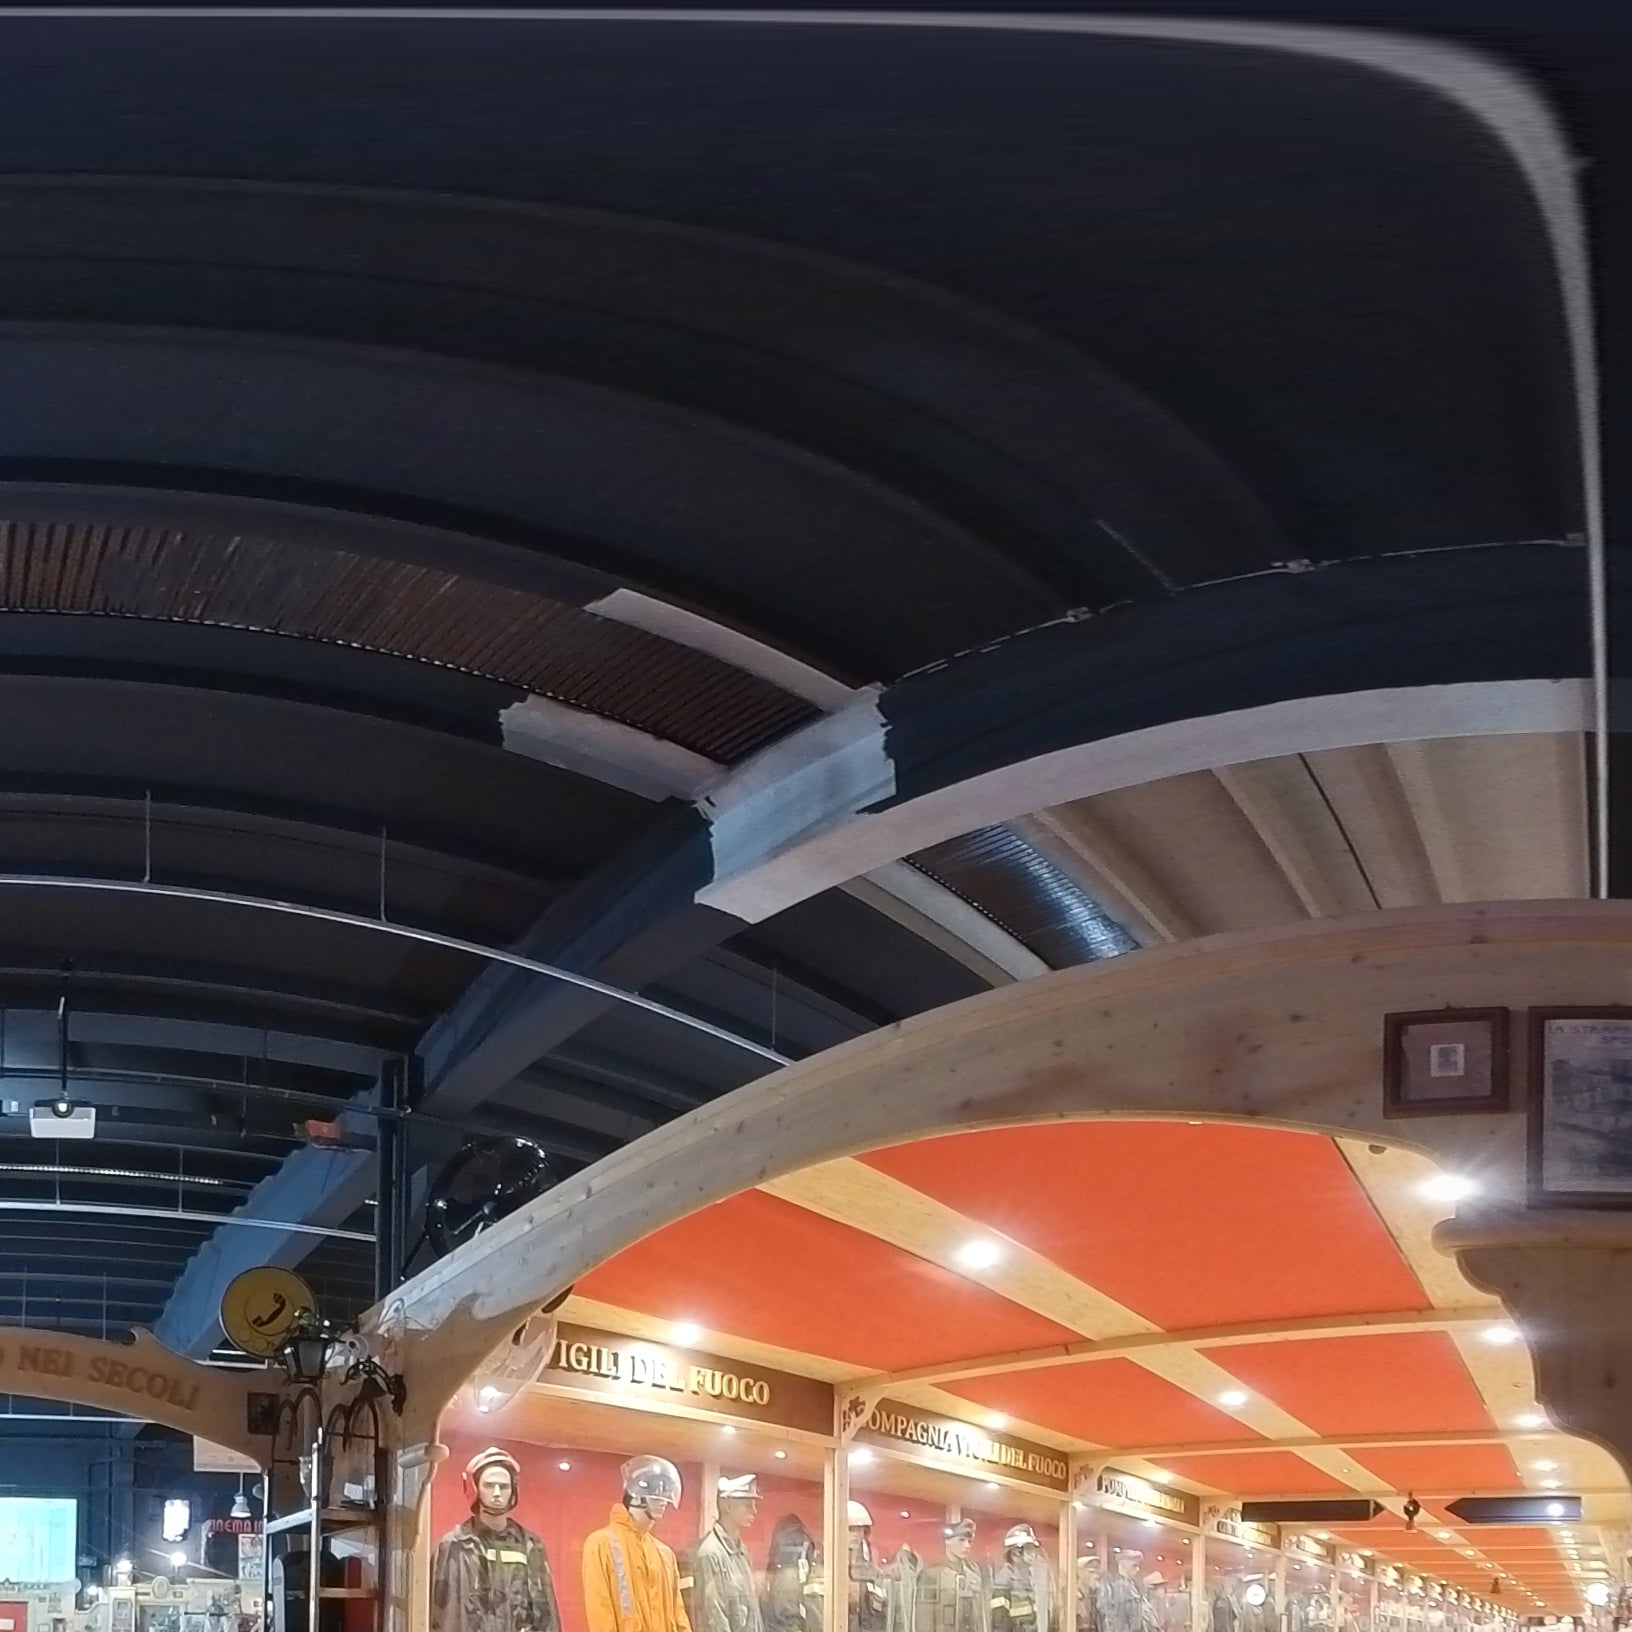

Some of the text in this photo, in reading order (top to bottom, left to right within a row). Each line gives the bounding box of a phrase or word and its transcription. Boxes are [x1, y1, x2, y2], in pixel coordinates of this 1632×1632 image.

[17, 1345, 74, 1376] NEI
[89, 1356, 201, 1412] SECOLI
[688, 1365, 771, 1406] FUOCO
[1028, 1452, 1067, 1480] FUOCO
